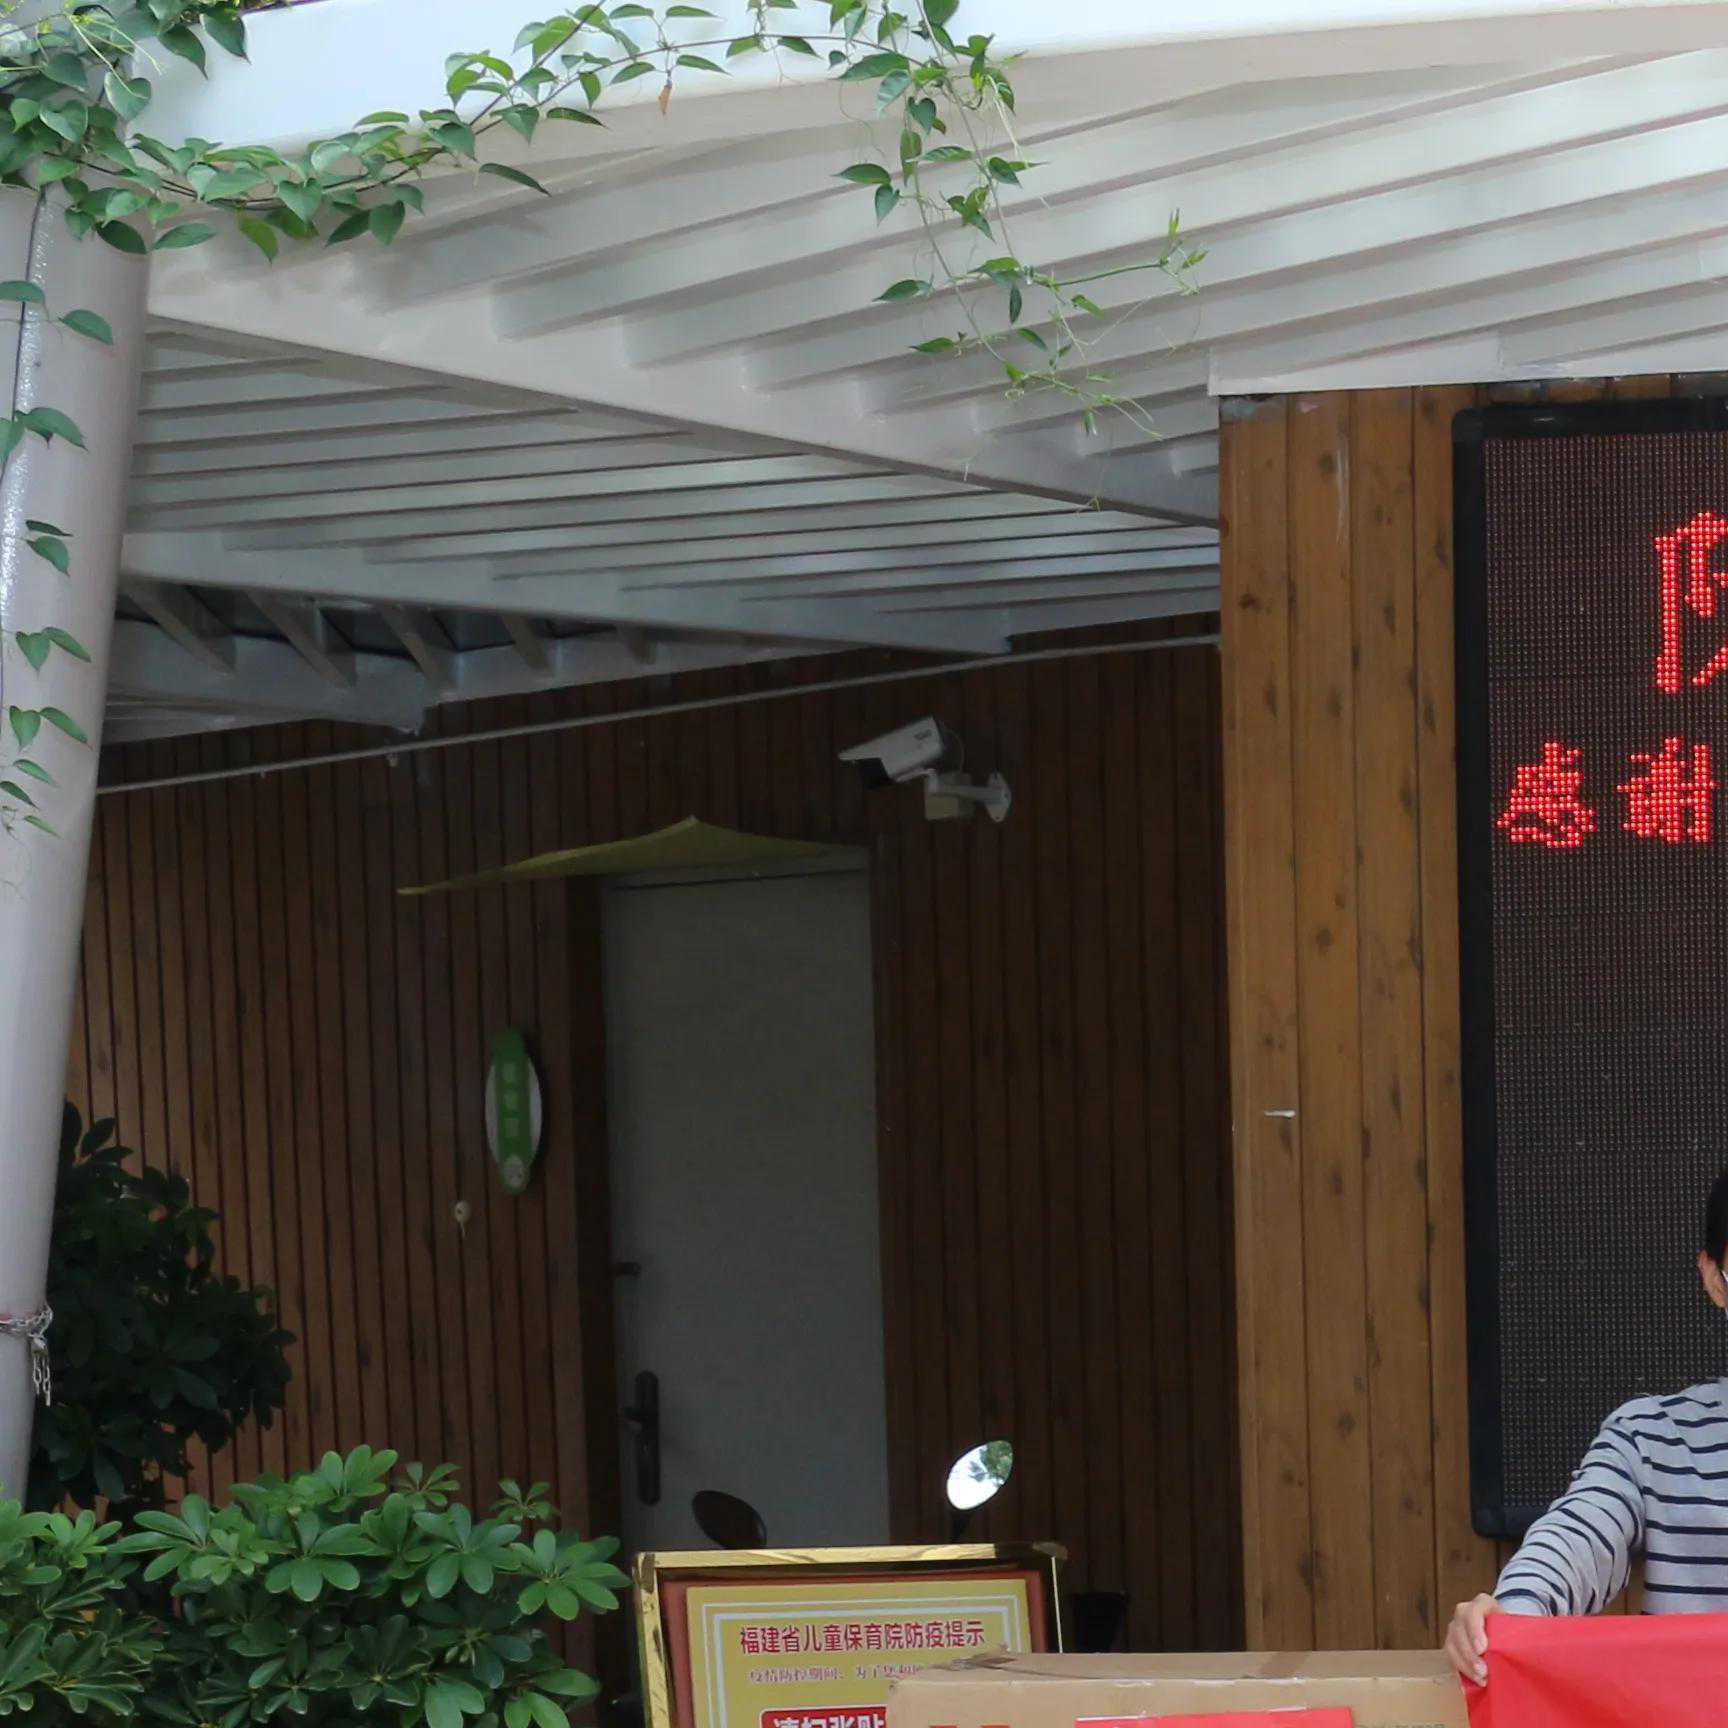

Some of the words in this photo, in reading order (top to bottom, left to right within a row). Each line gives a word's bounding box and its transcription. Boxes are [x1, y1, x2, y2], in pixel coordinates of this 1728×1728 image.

[740, 1620, 986, 1655] 福建省儿童保育院防疫提示
